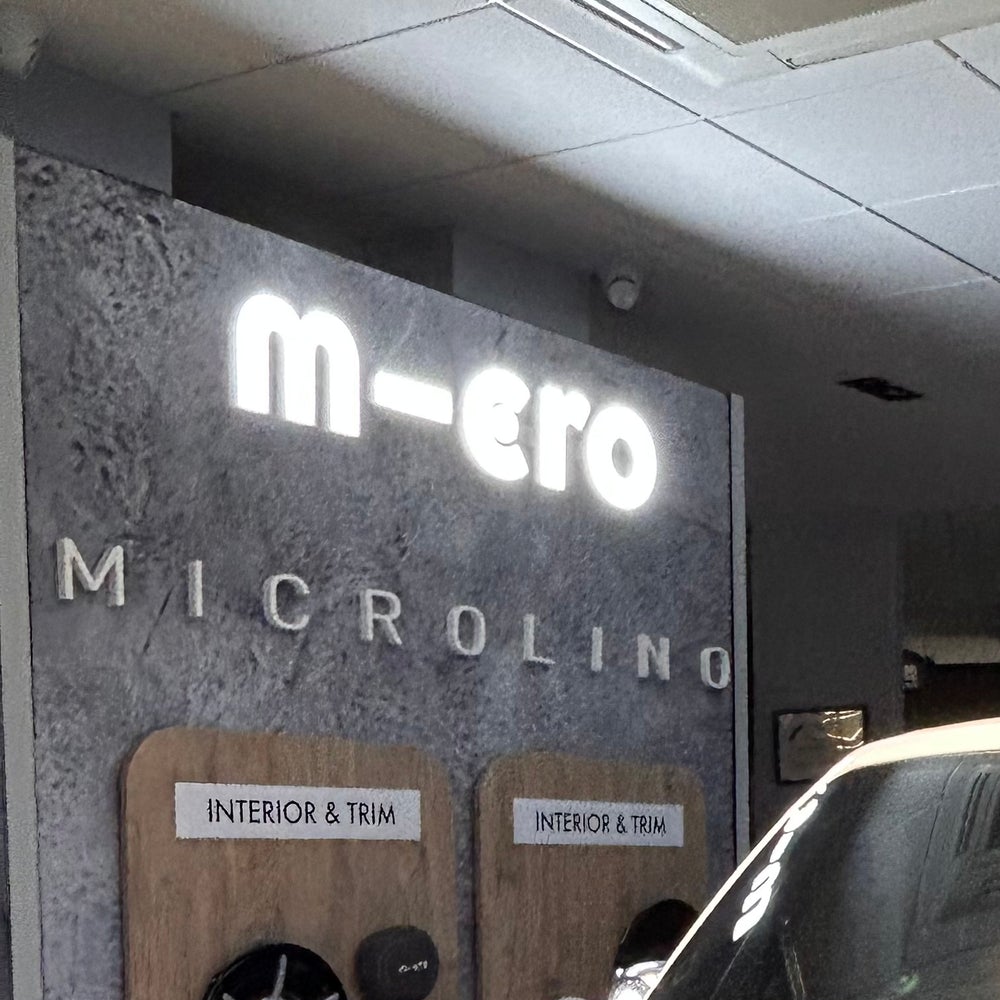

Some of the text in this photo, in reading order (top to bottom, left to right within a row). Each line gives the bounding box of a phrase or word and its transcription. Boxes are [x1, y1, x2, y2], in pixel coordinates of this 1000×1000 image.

[56, 537, 731, 690] MICROLINO
[207, 798, 396, 826] INTERIOR & TRIM
[536, 810, 667, 835] INTERIOR & TRIM
